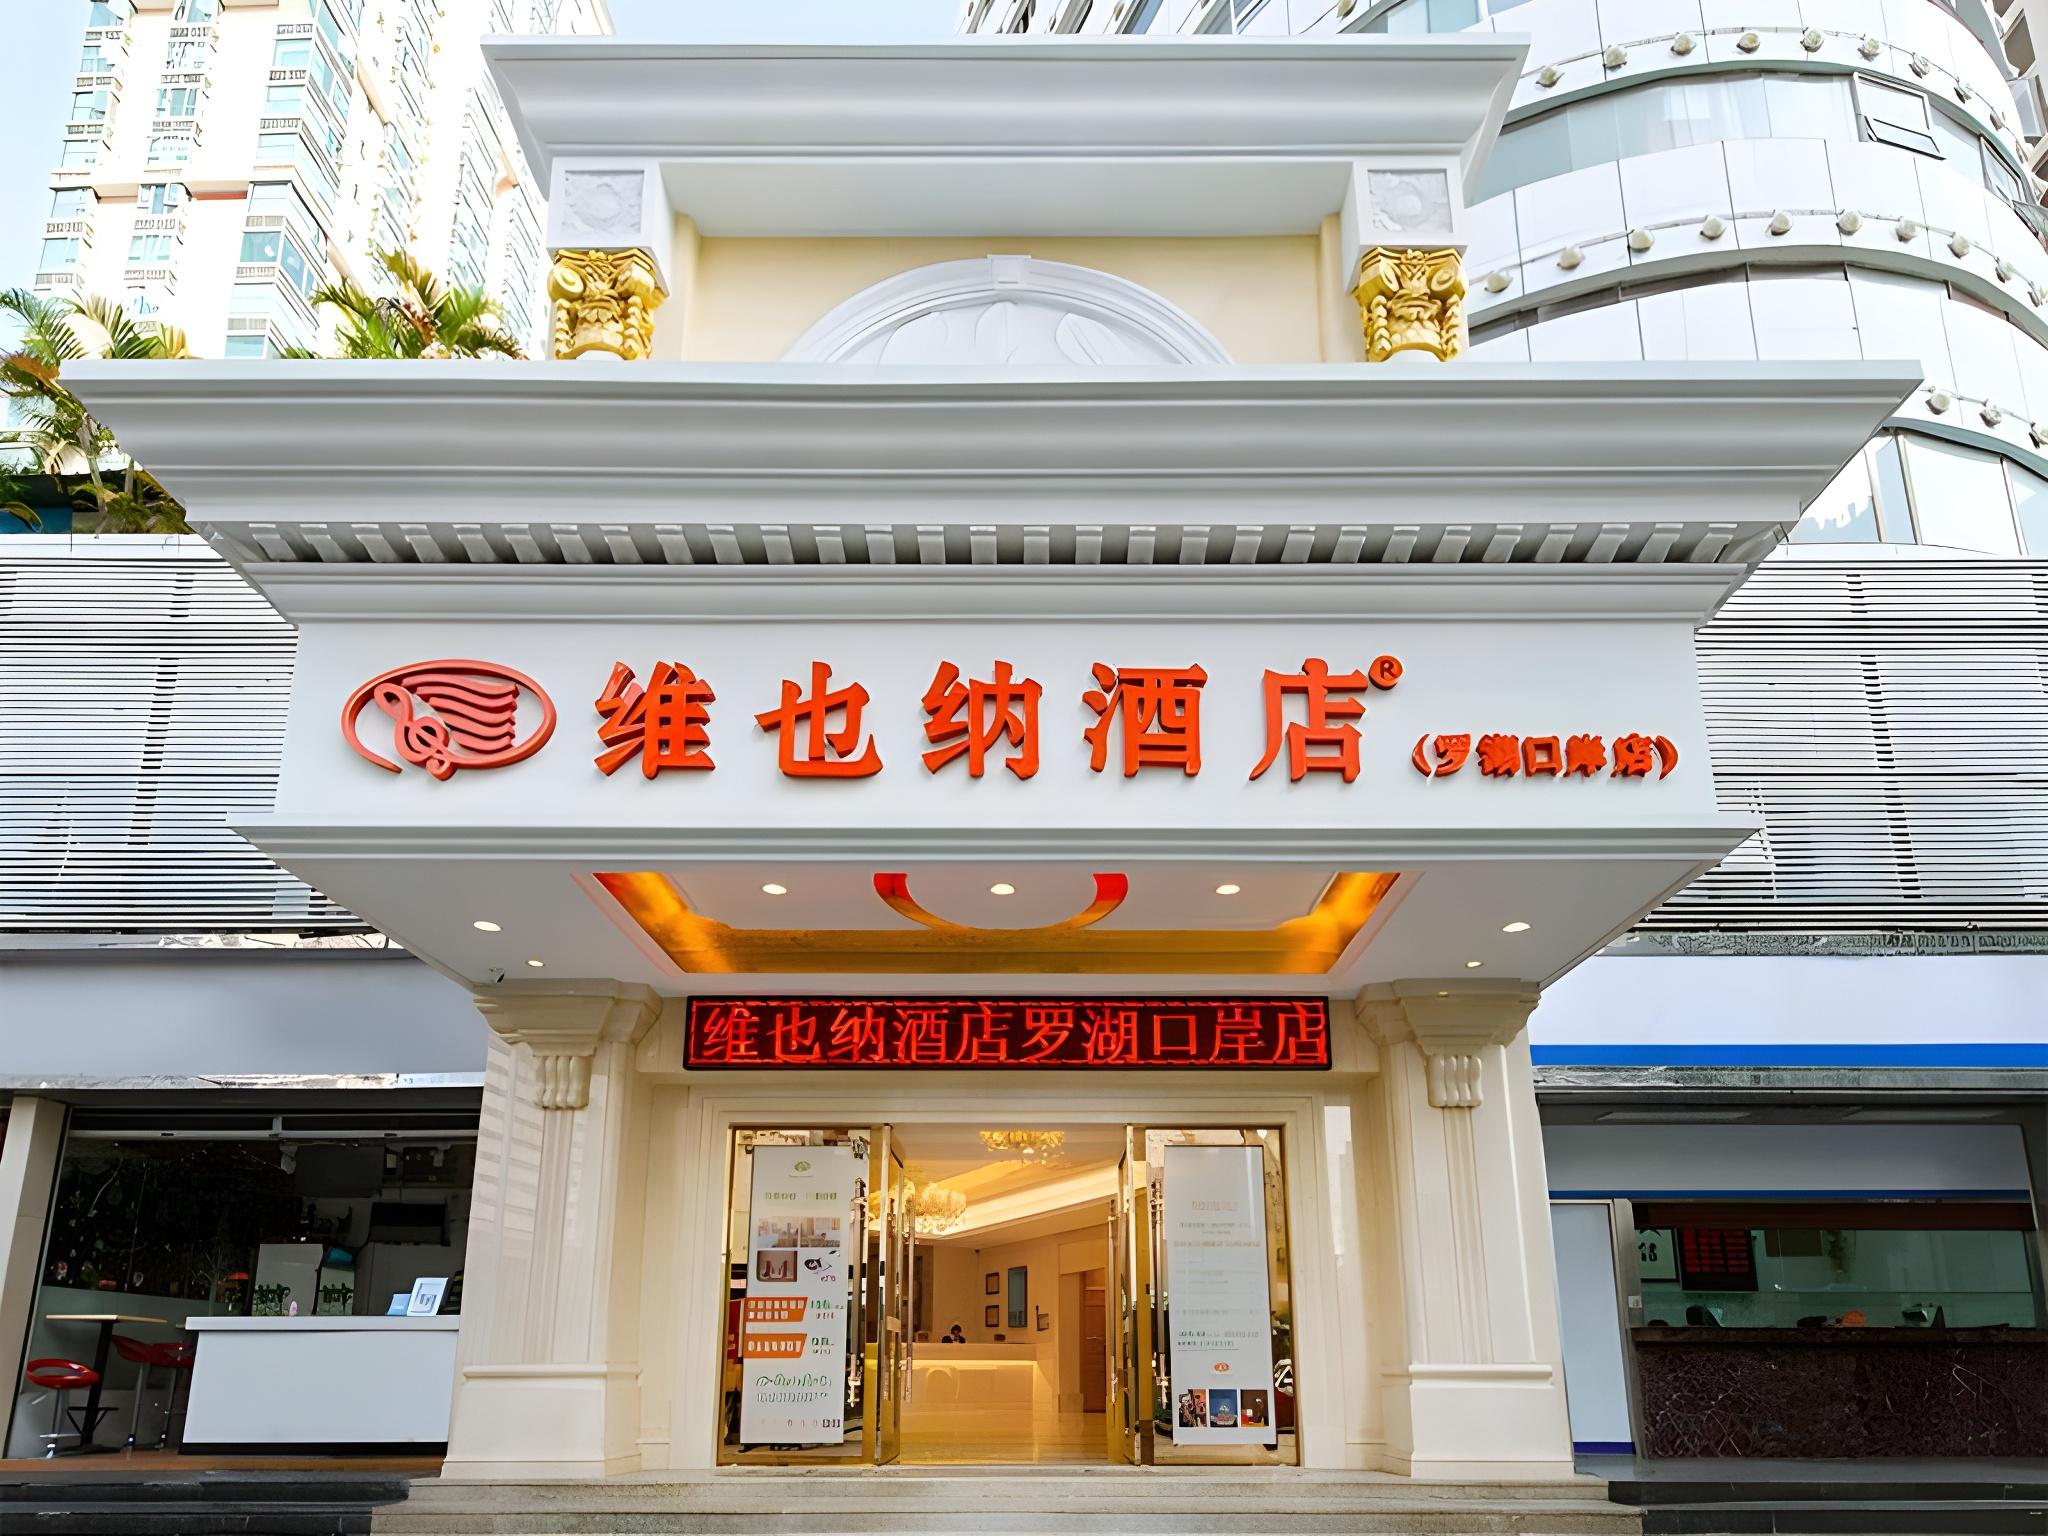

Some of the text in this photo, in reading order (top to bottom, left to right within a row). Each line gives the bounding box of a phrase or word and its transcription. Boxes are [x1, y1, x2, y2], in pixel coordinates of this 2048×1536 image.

[702, 1002, 1325, 1063] 维也纳酒店罗湖口岸店
